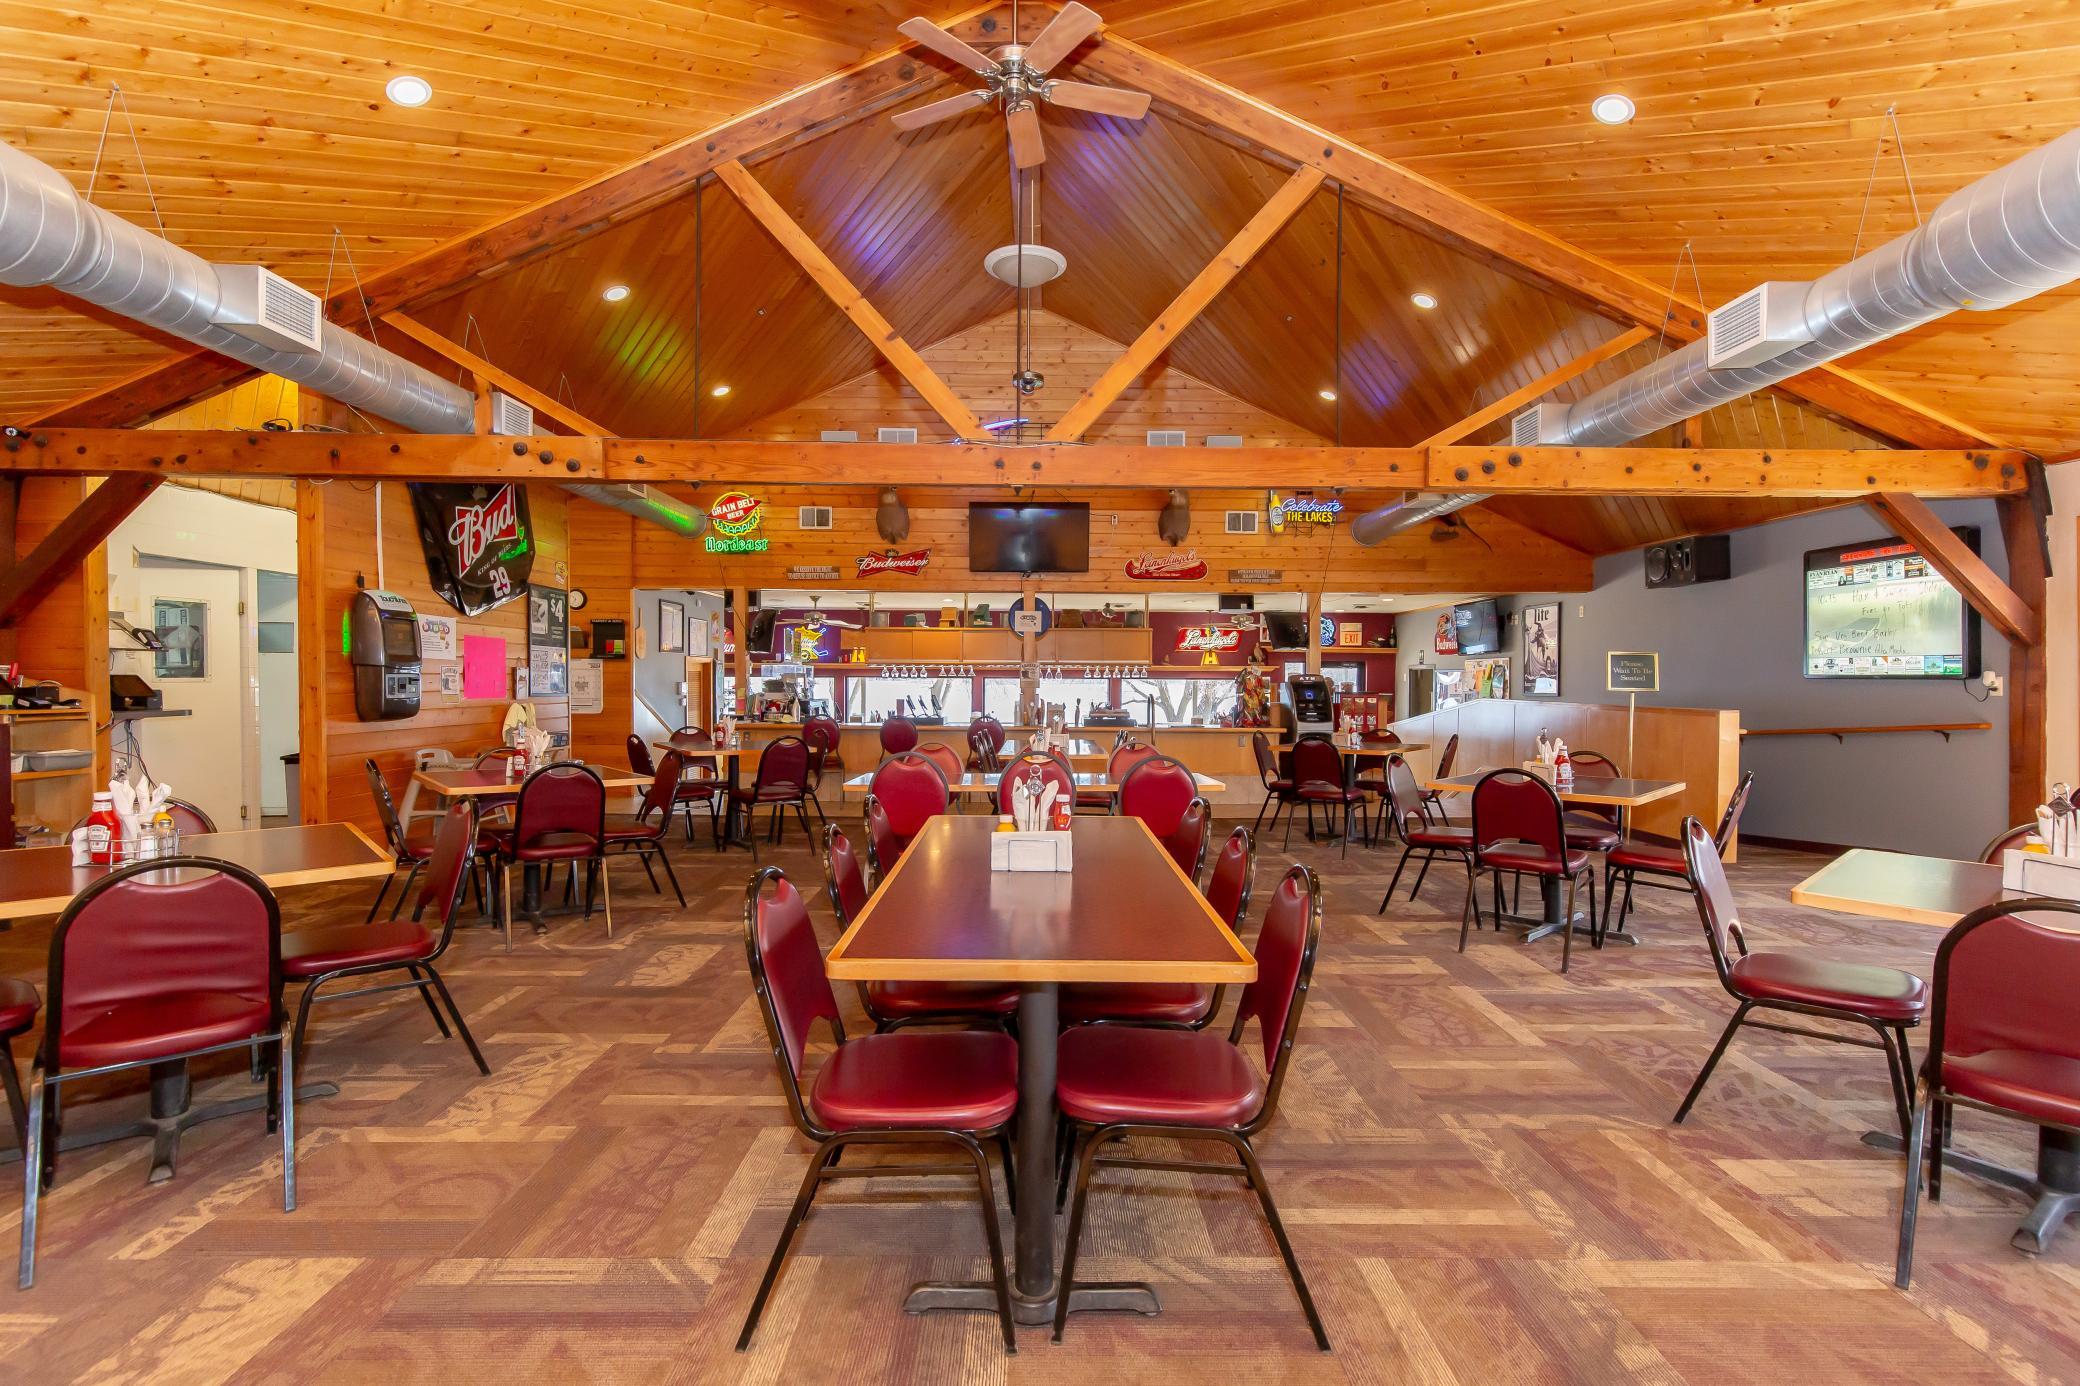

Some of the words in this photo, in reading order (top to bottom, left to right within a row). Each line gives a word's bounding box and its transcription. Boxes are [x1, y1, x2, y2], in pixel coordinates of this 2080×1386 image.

[712, 502, 736, 516] GRAIN
[737, 497, 755, 508] BELT
[1280, 498, 1344, 512] Celebrate
[726, 509, 745, 520] BEER
[1286, 511, 1303, 522] THE
[1305, 511, 1333, 523] LAKES
[448, 485, 514, 567] Bud
[705, 535, 769, 552] Nordeast
[477, 563, 491, 576] KING
[856, 556, 929, 571] Budweiser
[1133, 549, 1197, 574] Leinenkugel's
[489, 566, 511, 599] 29
[550, 598, 565, 623] $4
[1344, 633, 1359, 644] EXIT
